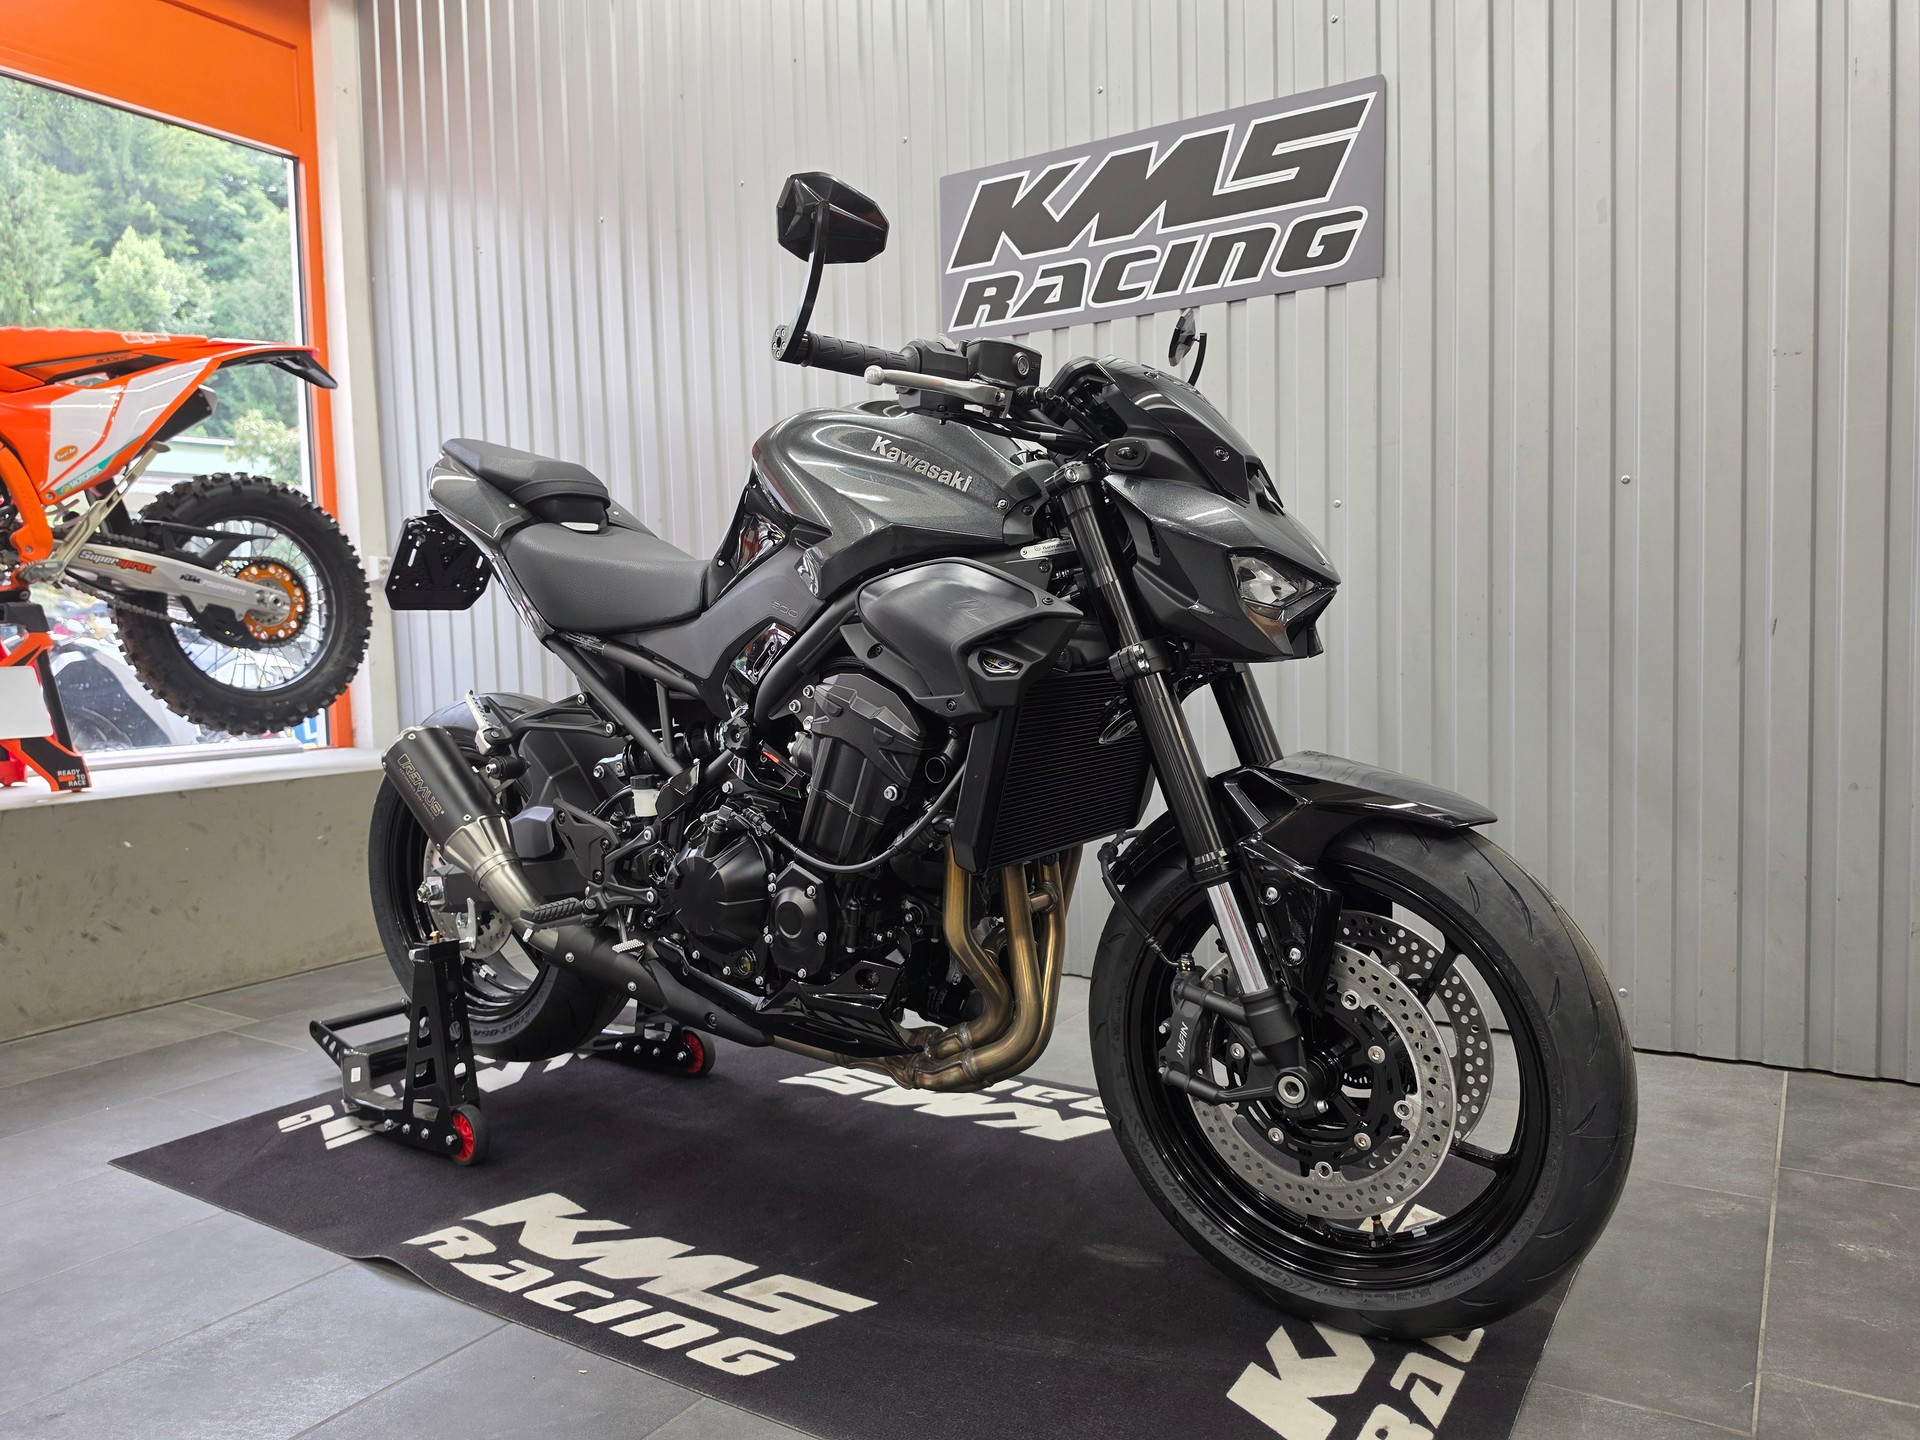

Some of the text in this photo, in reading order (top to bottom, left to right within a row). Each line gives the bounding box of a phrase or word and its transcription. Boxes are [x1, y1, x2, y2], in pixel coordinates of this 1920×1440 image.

[946, 91, 1377, 274] KMS
[947, 205, 1368, 332] RACING
[871, 435, 974, 493] Kawasaki
[57, 769, 81, 777] READY
[68, 779, 87, 788] RACE
[76, 773, 86, 781] TO
[401, 761, 443, 817] REMUS
[462, 1192, 879, 1335] KMS
[401, 1225, 796, 1376] RACING
